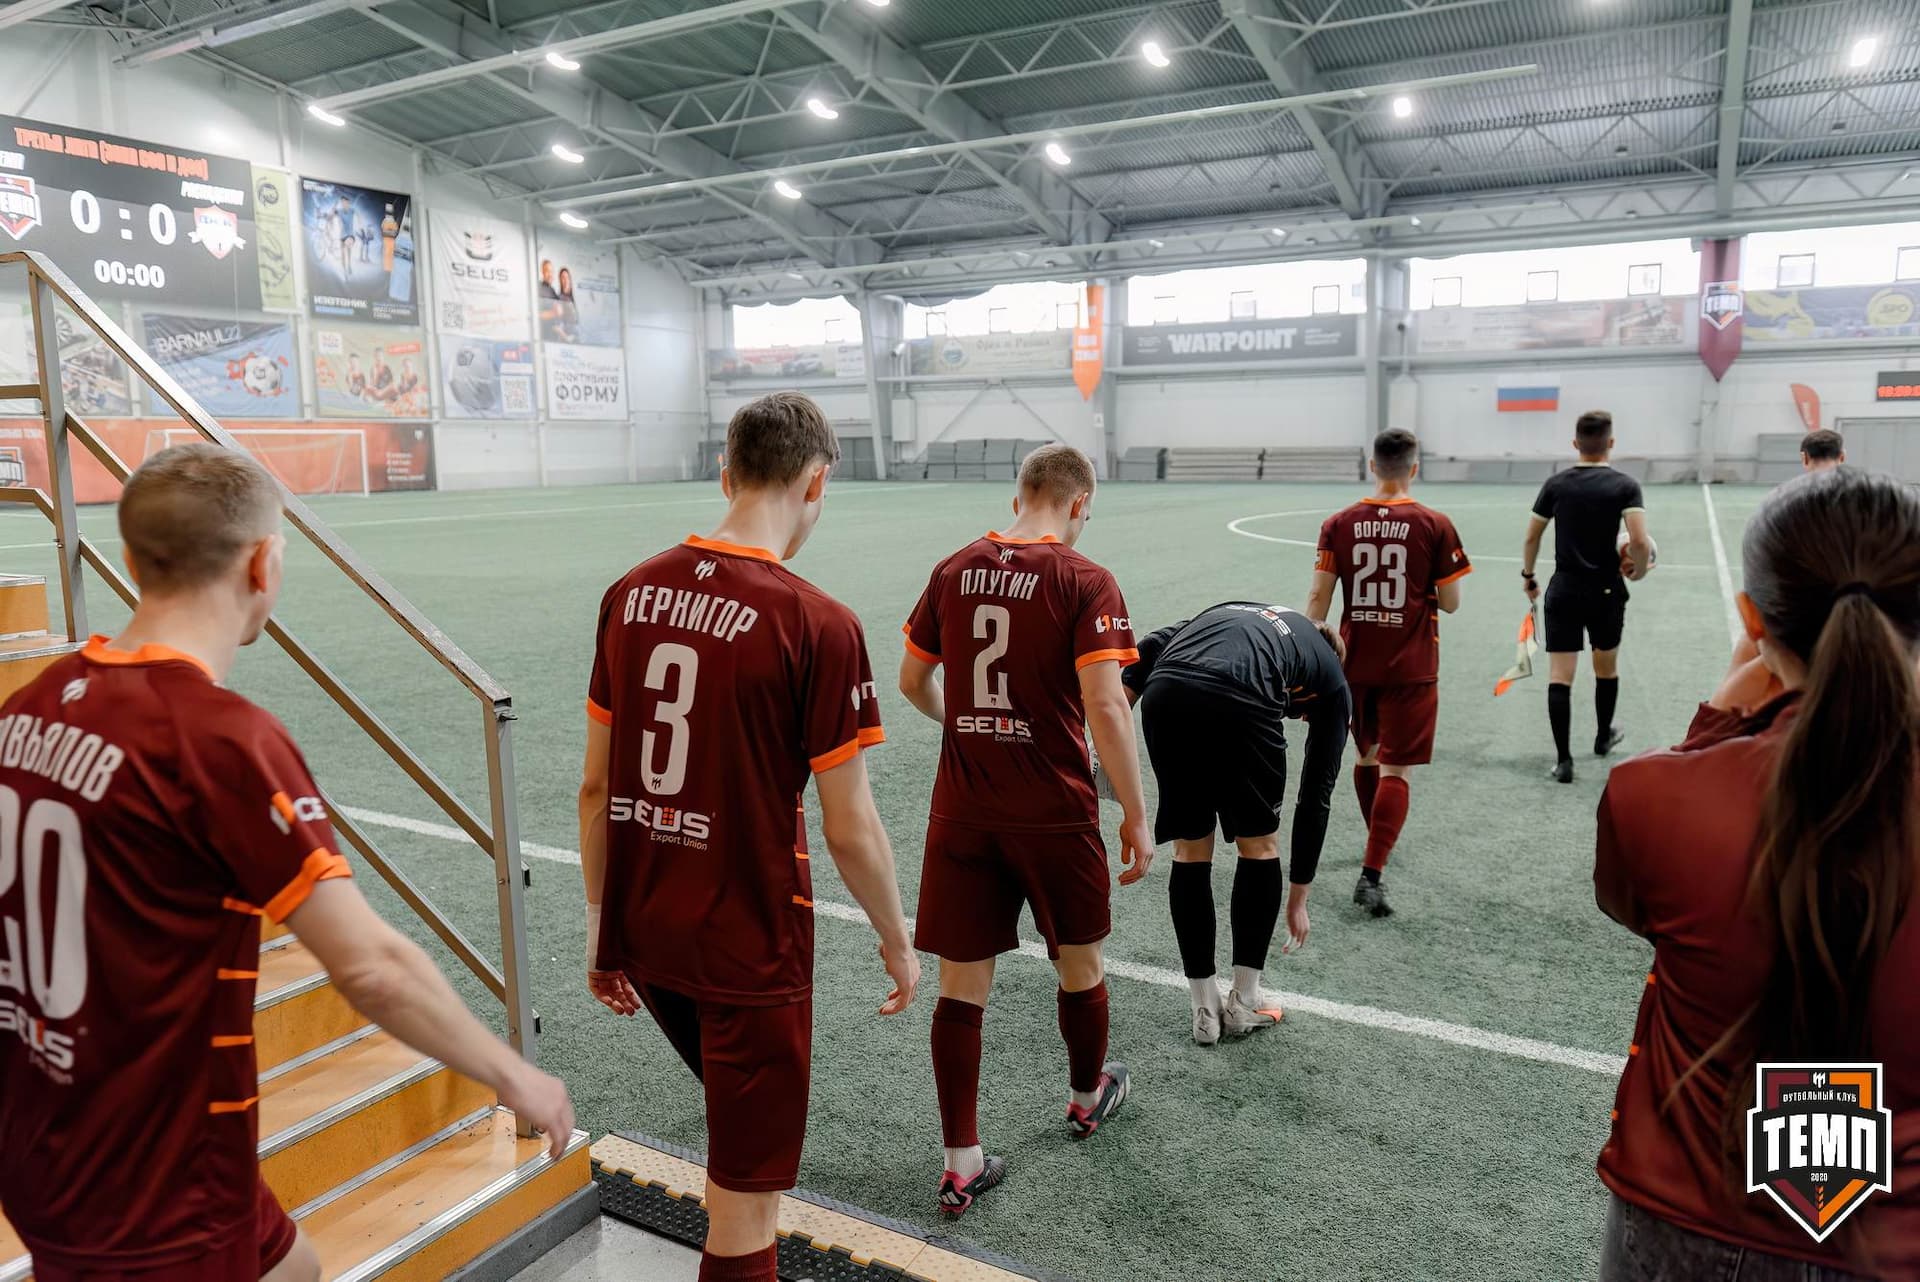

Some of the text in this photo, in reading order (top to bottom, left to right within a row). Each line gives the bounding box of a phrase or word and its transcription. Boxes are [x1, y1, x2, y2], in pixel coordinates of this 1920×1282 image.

[70, 189, 101, 234] 0
[149, 203, 177, 246] 0
[94, 259, 166, 289] 00:00
[451, 262, 510, 282] SEUS
[1168, 328, 1298, 355] WARPOINT
[555, 383, 619, 403] ФОРМУ
[1353, 520, 1410, 540] ВОРОНА
[960, 568, 1039, 600] ПЛУГИН
[1351, 543, 1407, 609] 23
[623, 585, 759, 642] ВЕРНИГОР
[1351, 610, 1404, 625] SEUS
[972, 604, 1013, 710] 2
[640, 642, 699, 796] 3
[956, 716, 1032, 738] SEUS
[609, 796, 711, 840] SEUS
[650, 831, 708, 851] Export Union
